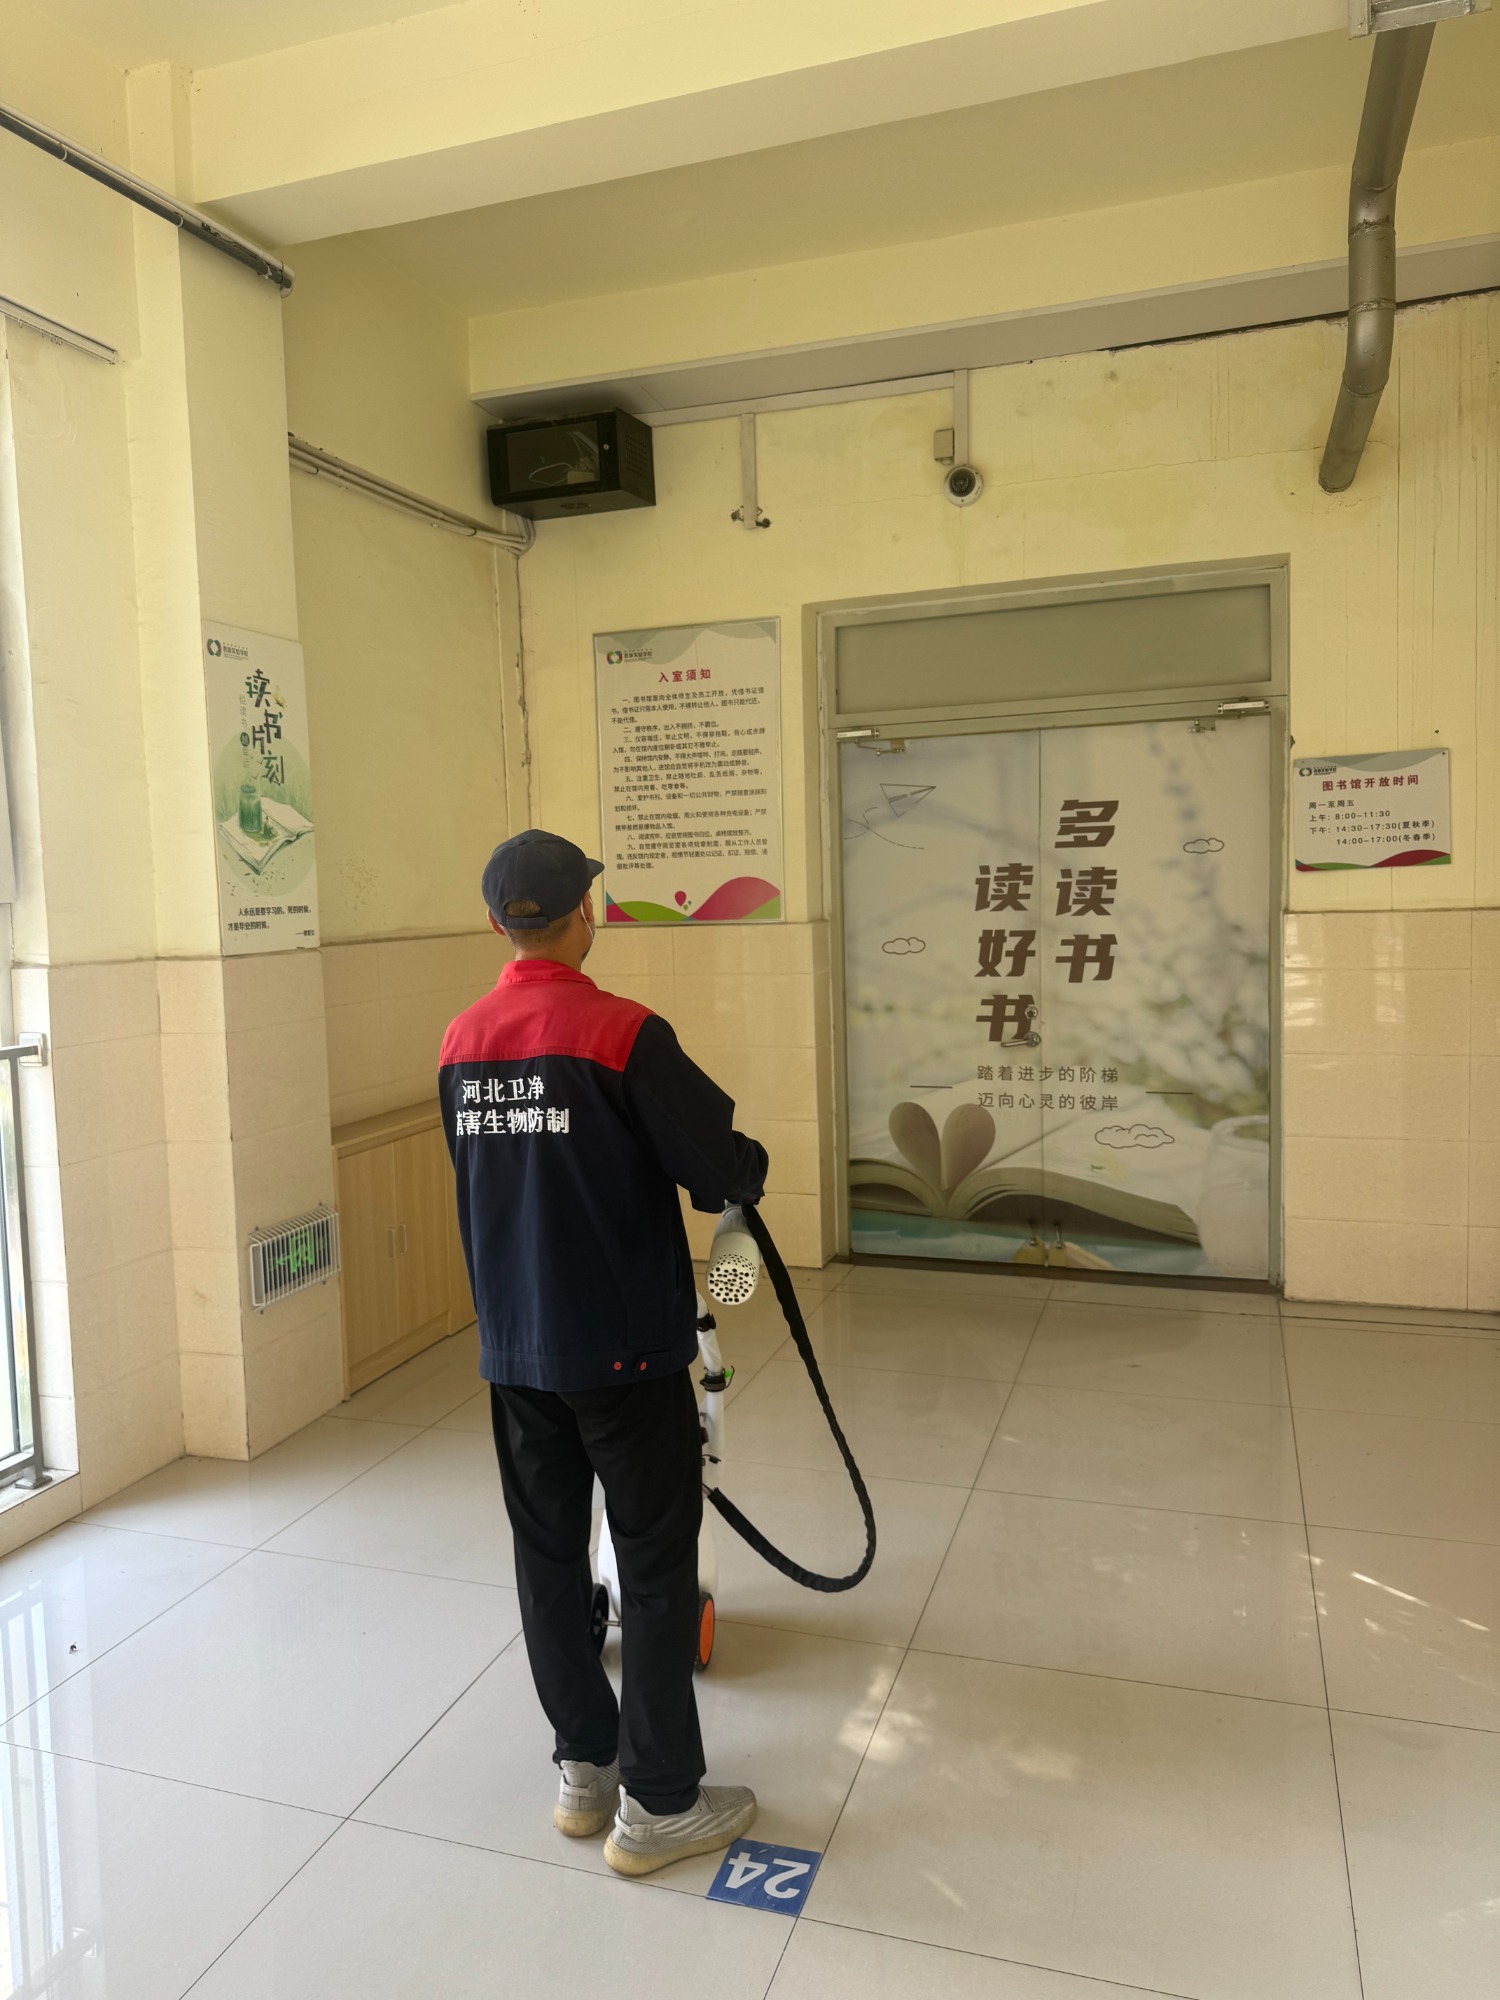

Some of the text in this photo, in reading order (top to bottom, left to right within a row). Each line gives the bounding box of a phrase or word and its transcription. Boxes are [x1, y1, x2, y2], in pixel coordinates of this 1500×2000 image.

[658, 668, 711, 683] 入室须知
[1322, 774, 1419, 792] 图书馆开放时间
[1308, 800, 1355, 810] 周一至周五
[1054, 799, 1120, 984] 多读书
[974, 863, 1038, 1043] 读好书
[976, 1065, 1119, 1084] 踏着进步的阶梯
[462, 1074, 545, 1104] 河北卫净
[977, 1092, 1119, 1112] 迈向心灵的彼岸
[725, 1851, 811, 1899] 24
